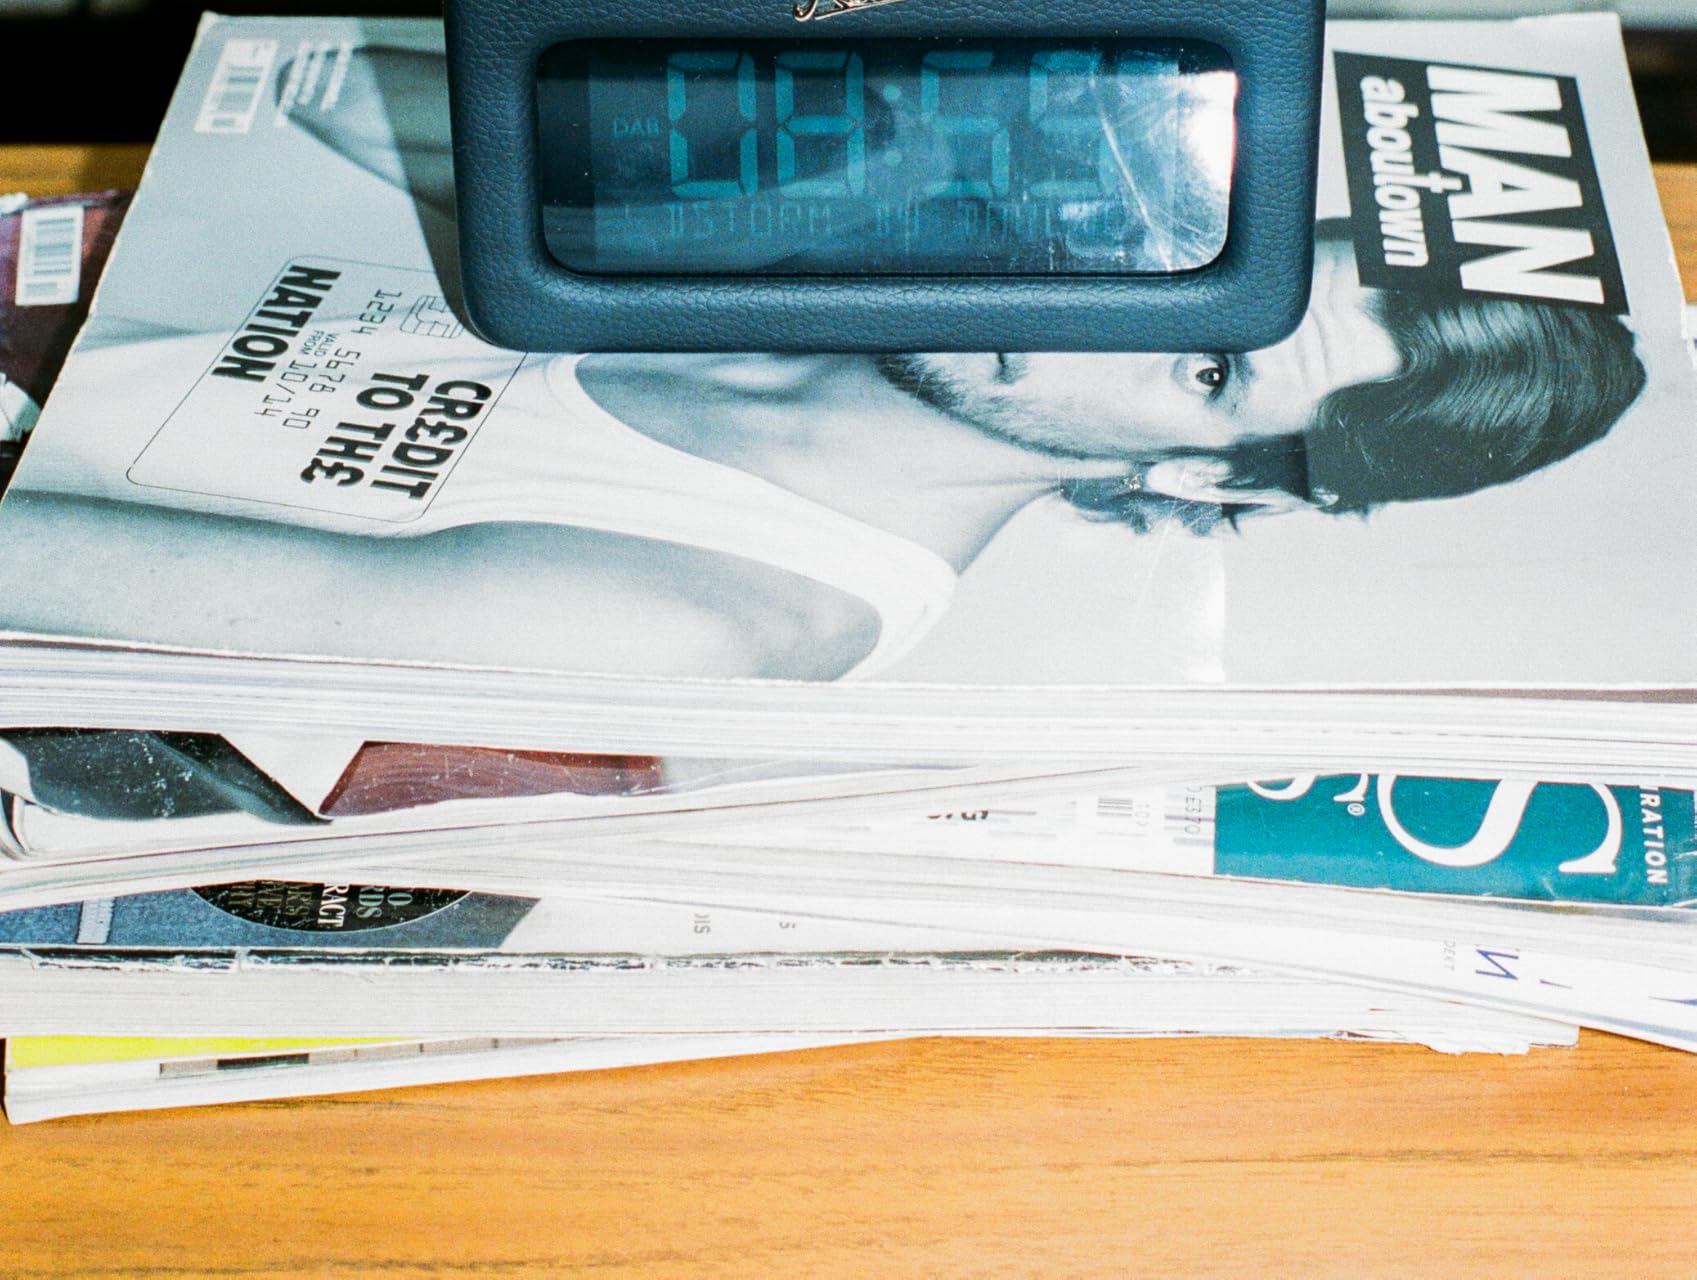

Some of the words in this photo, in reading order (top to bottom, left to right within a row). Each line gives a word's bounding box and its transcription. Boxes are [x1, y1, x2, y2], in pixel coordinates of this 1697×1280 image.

[612, 117, 660, 139] DAB
[1427, 65, 1604, 304] MAN
[211, 265, 342, 382] NATION
[351, 289, 402, 336] 1234
[300, 330, 325, 355] FROM
[315, 333, 340, 357] VALID
[254, 360, 317, 417] 10/14
[308, 348, 361, 393] 5678
[356, 372, 429, 412] TO
[282, 408, 320, 430] 90
[1639, 785, 1668, 884] RATION
